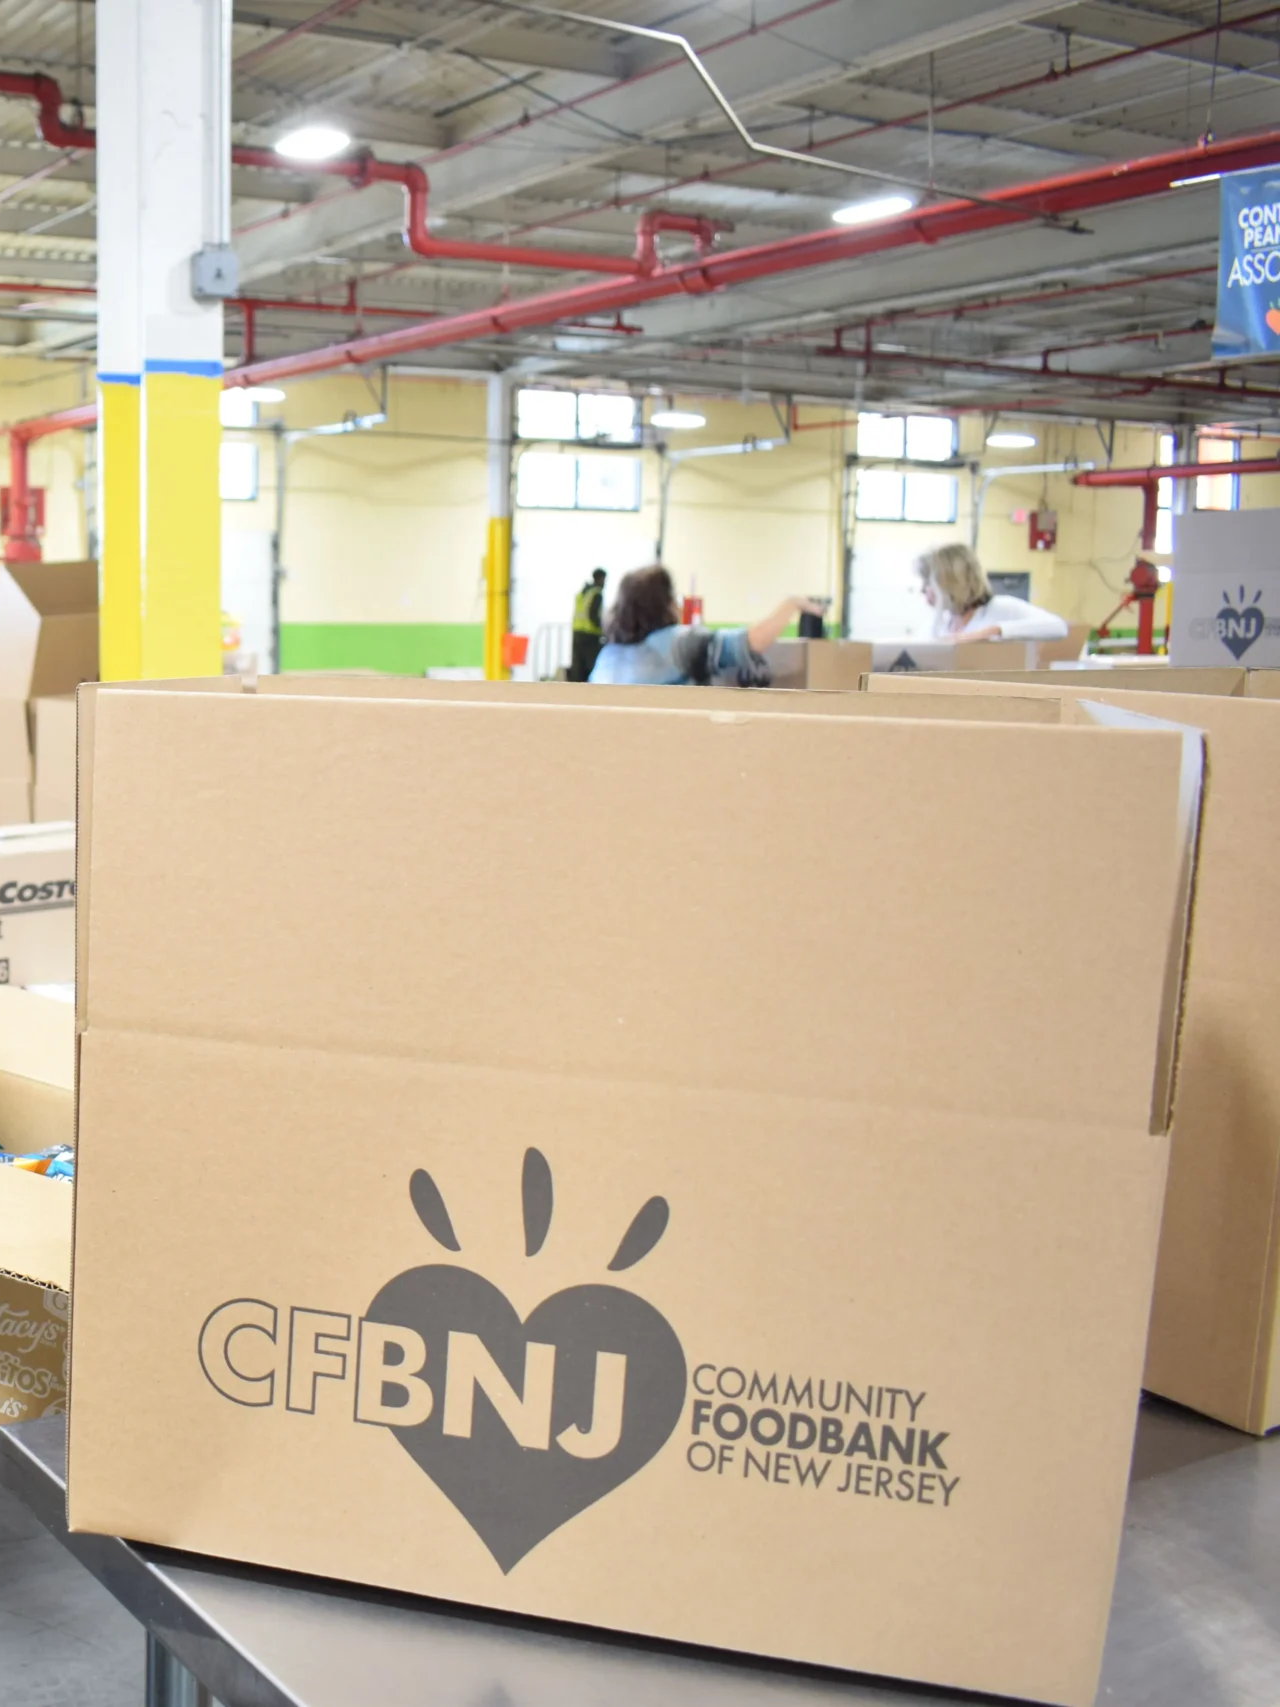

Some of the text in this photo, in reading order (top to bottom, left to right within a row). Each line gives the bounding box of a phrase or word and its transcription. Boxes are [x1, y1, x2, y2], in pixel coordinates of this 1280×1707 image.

[198, 1297, 627, 1459] CFBNJ
[692, 1363, 927, 1422] COMMUNITY
[691, 1399, 951, 1470] FOODBANK
[686, 1441, 961, 1507] OF NEW JERSEY
